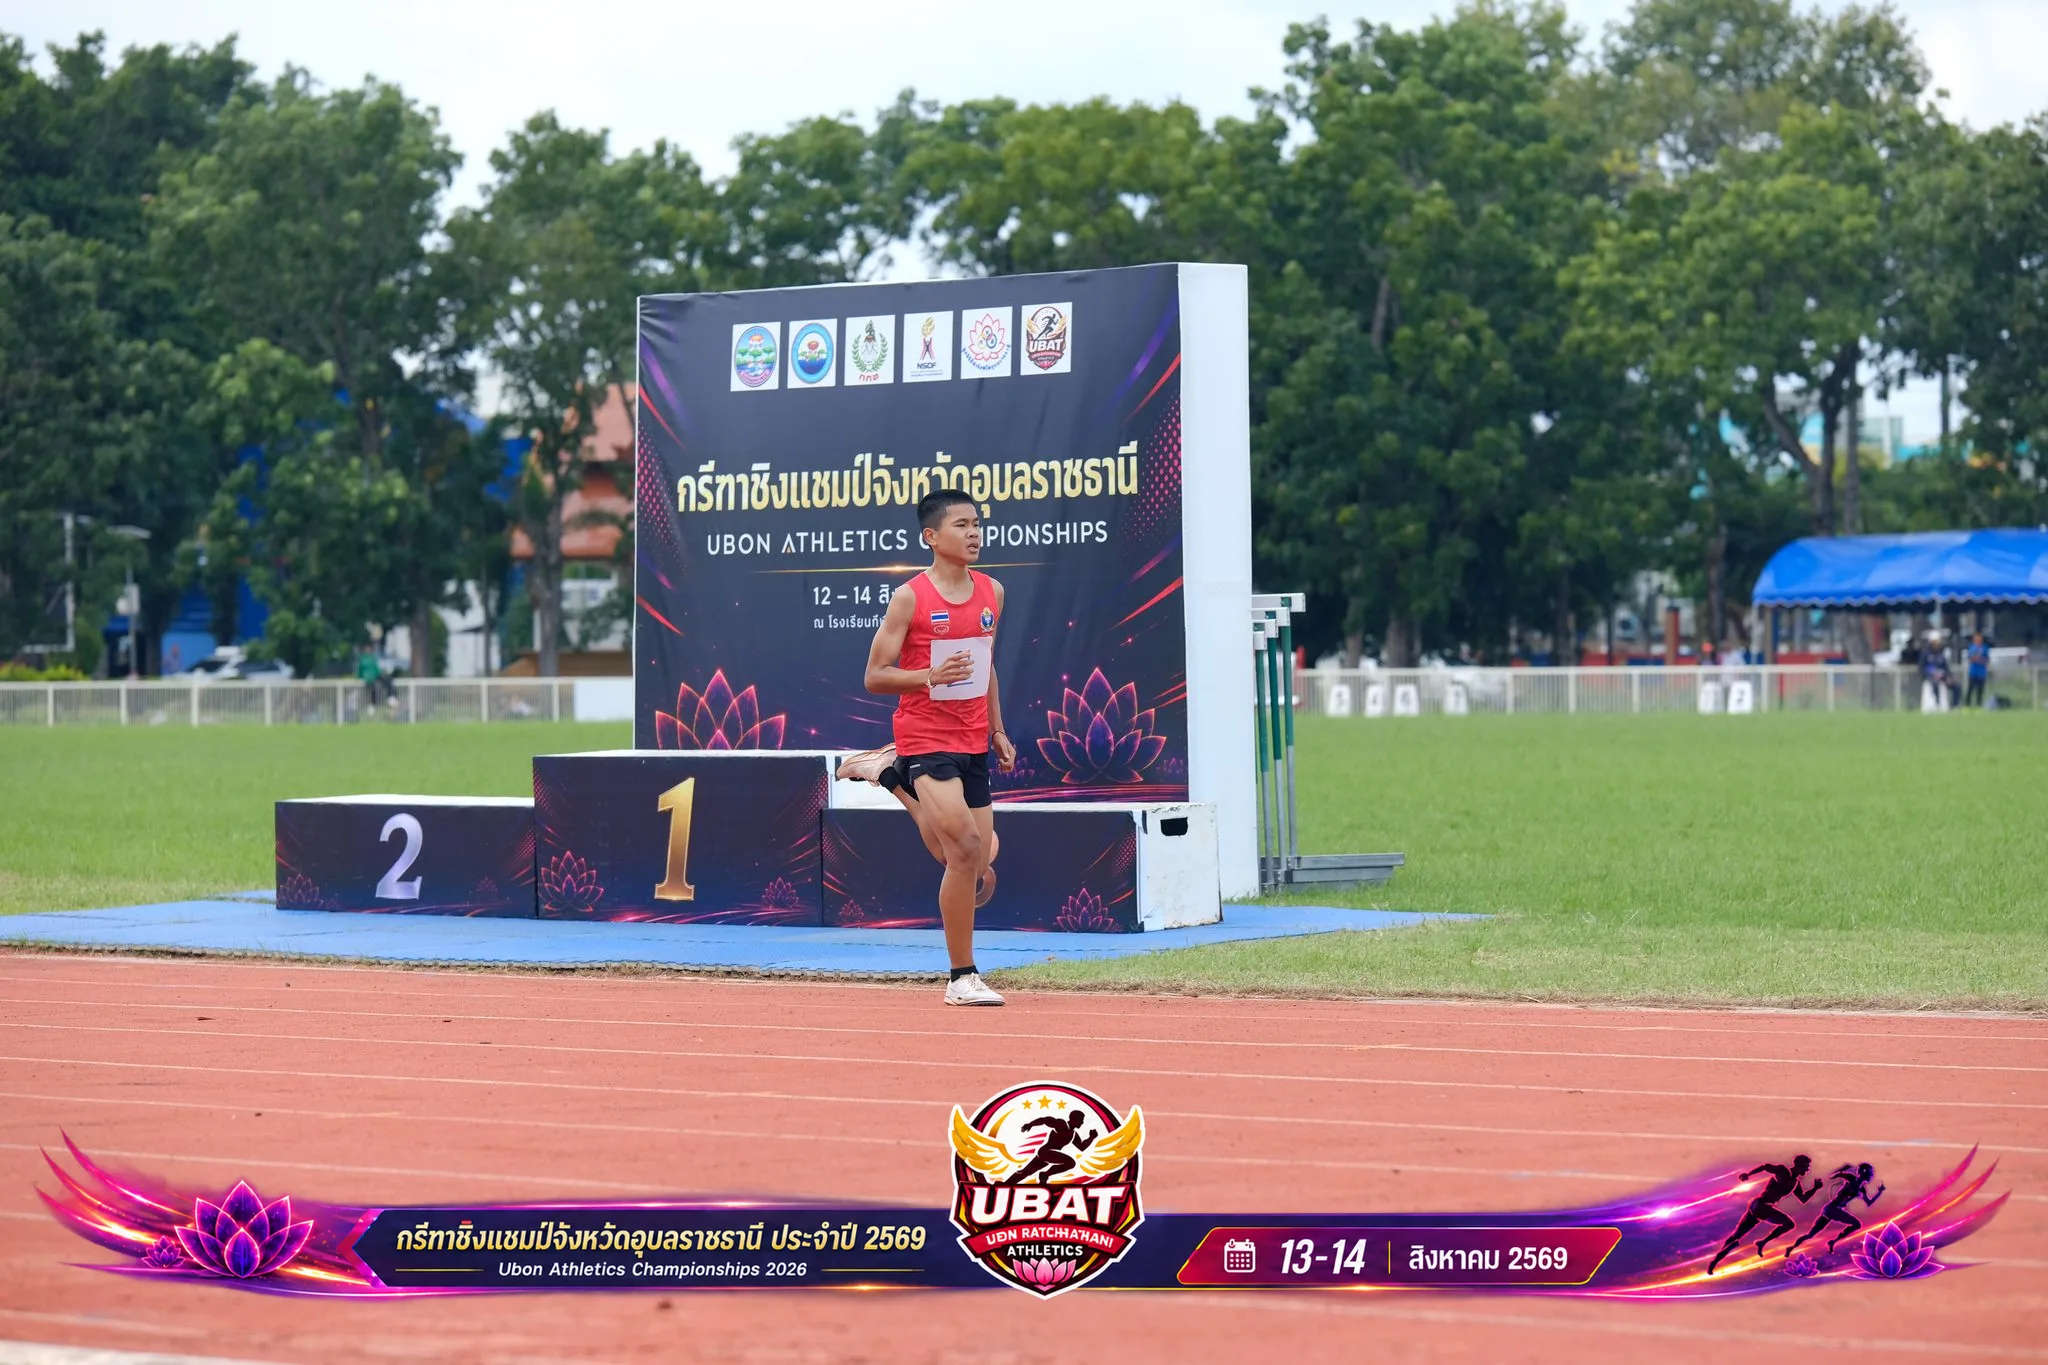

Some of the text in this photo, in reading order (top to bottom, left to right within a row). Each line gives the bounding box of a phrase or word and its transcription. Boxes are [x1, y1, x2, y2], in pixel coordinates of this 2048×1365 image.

[1028, 338, 1064, 353] UBAT
[707, 532, 771, 556] UBON
[781, 528, 908, 554] ATHLETICS
[813, 586, 831, 605] 12
[853, 585, 872, 604] 14
[654, 777, 696, 902] 1
[374, 812, 424, 900] 2
